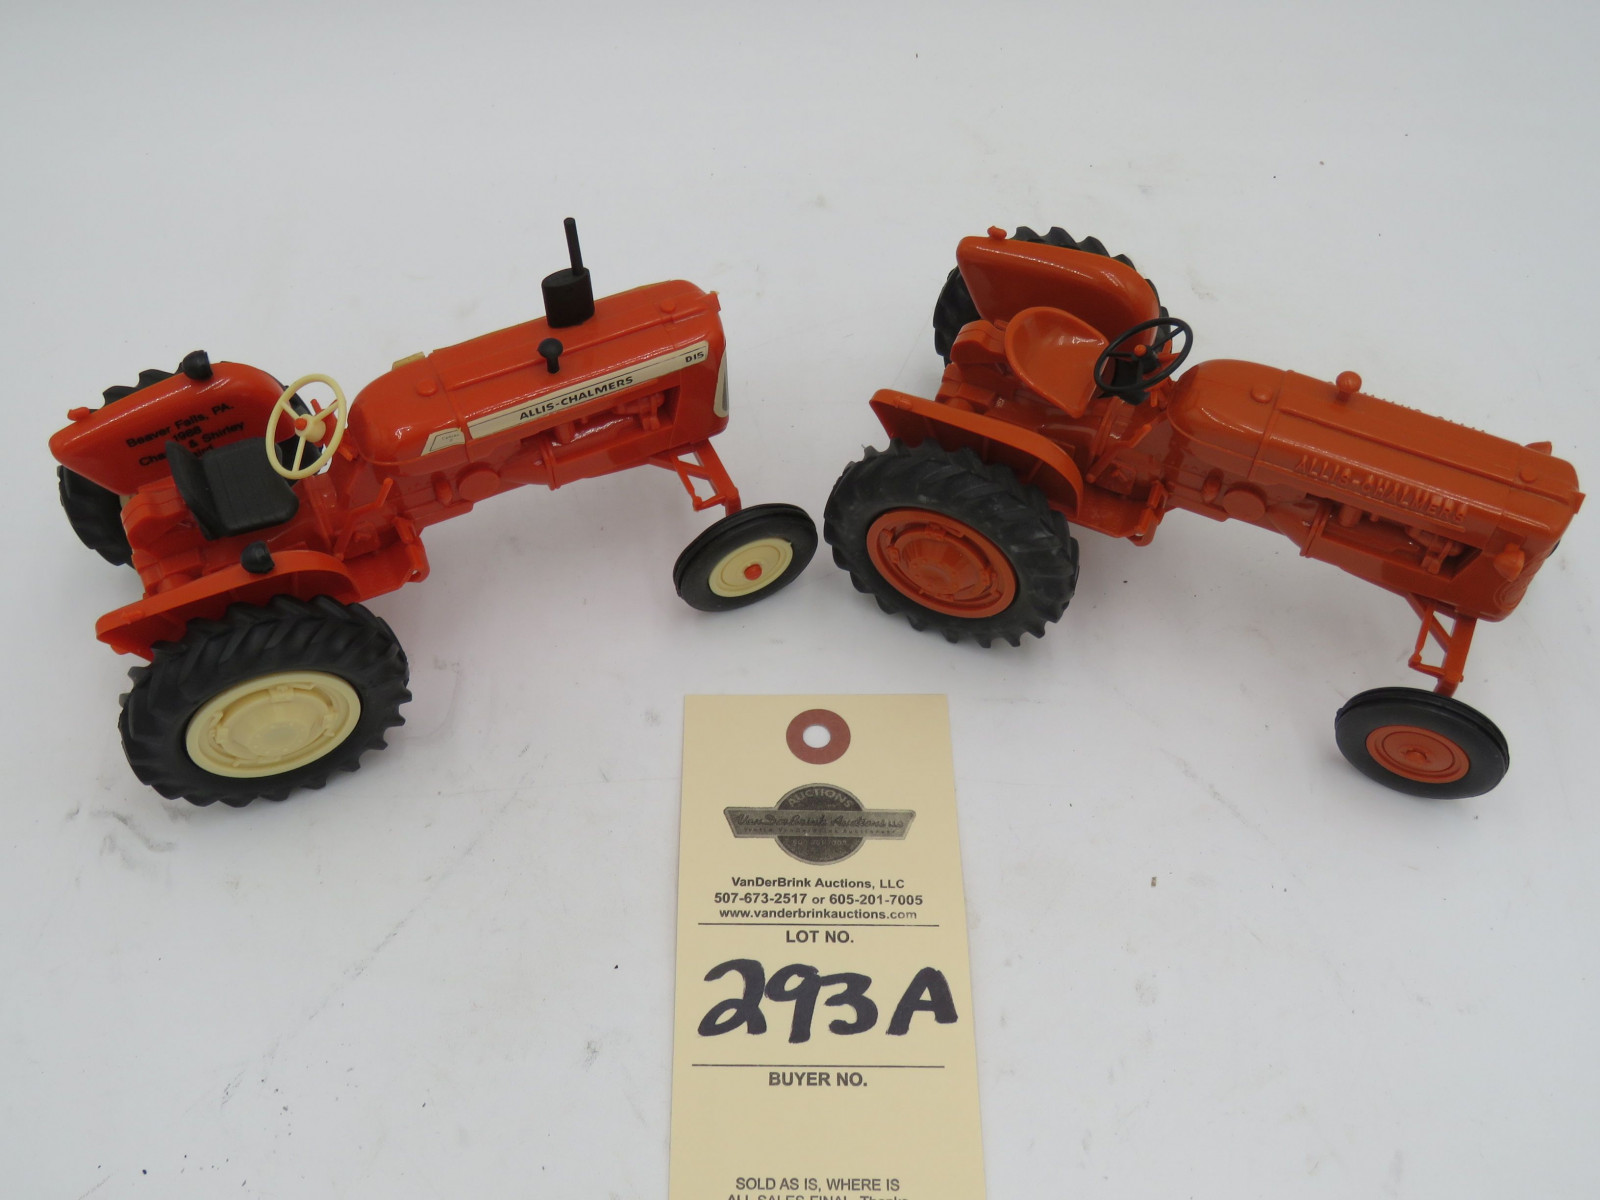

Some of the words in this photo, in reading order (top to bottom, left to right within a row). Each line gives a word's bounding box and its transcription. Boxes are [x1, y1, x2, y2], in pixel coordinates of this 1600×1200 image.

[519, 376, 634, 421] ALLIS-CHALMERS
[126, 426, 170, 448] Beaver
[174, 414, 209, 429] Falls,
[211, 403, 234, 415] PA.
[202, 421, 245, 443] Shirley
[1296, 454, 1468, 523] ALLIS-CHALMERS
[788, 788, 855, 809] AUCTIONS
[731, 876, 811, 888] VanDerBrink
[814, 877, 875, 890] Auctions,
[879, 879, 905, 889] LLC
[714, 892, 808, 904] 507-673-2517
[811, 895, 826, 905] or
[829, 894, 923, 906] 605-201-7005
[719, 907, 918, 919] www.vanderbrinkauctions.com
[786, 930, 820, 943] LOT
[824, 931, 855, 943] NO.
[885, 966, 959, 1036] A
[768, 1072, 831, 1087] BUYER
[836, 1073, 868, 1087] NO.
[735, 1177, 776, 1190] SOLD
[779, 1178, 800, 1190] AS
[804, 1178, 822, 1192] IS,
[826, 1178, 881, 1191] WHERE
[886, 1179, 900, 1191] IS
